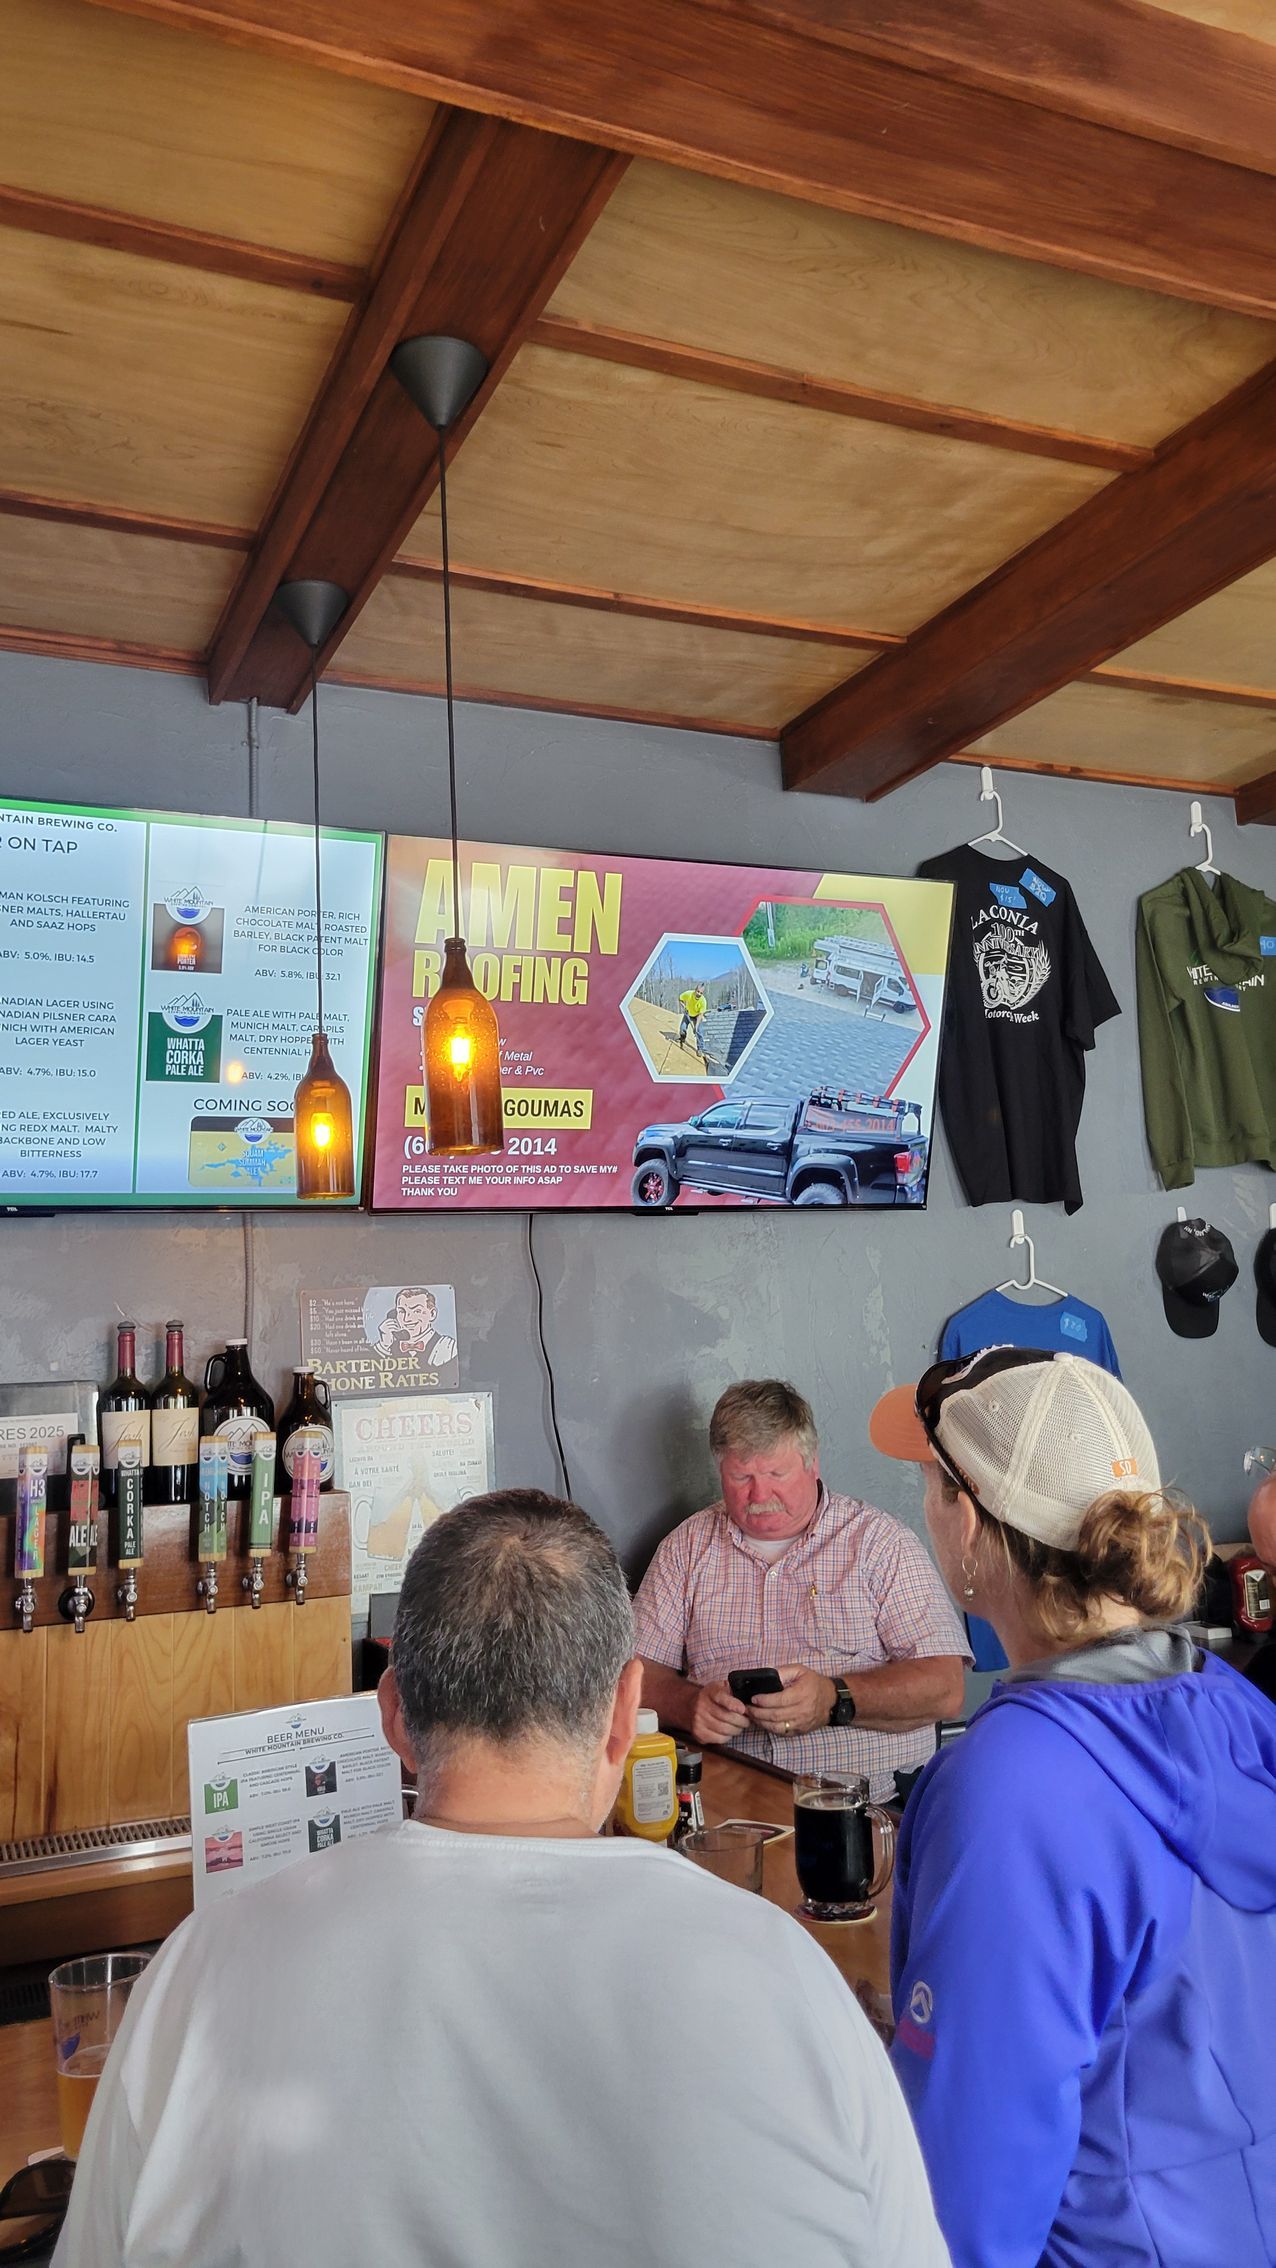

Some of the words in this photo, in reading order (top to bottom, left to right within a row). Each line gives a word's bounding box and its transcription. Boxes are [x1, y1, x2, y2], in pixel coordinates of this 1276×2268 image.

[38, 817, 94, 830] BREWING
[97, 822, 117, 832] CO.
[8, 836, 36, 851] ON
[42, 839, 78, 854] TAP
[26, 893, 69, 904] KOLSCH
[71, 896, 130, 908] FEATURING
[414, 857, 623, 956] AMEN
[27, 906, 63, 917] MALTS,
[66, 909, 126, 921] HALLERTAU
[244, 905, 295, 917] AMERICAN
[297, 909, 337, 920] PORER,
[338, 912, 361, 921] RICH
[970, 904, 1040, 935] LACONIA
[10, 919, 34, 928] AND
[36, 920, 65, 930] SAAZ
[67, 922, 96, 932] HOPS
[236, 917, 294, 929] CHOCOLATE
[324, 923, 368, 934] ROASTED
[274, 932, 304, 942] BLACK
[344, 936, 369, 946] MALT
[258, 944, 278, 953] FOR
[279, 945, 310, 955] BLACK
[54, 953, 74, 962] IBU:
[77, 954, 95, 963] 14.5
[254, 969, 277, 978] ABV:
[411, 948, 589, 1006] ROFING
[0, 996, 43, 1007] NADIAN
[46, 999, 80, 1009] LAGER
[82, 1001, 114, 1010] USING
[160, 1004, 180, 1012] WHITE
[43, 1012, 86, 1022] PILSNER
[88, 1014, 117, 1023] CARA
[226, 1008, 250, 1018] PALE
[252, 1009, 270, 1019] ALE
[272, 1010, 296, 1020] WITH
[1013, 1009, 1040, 1024] Week
[0, 1023, 27, 1032] NICH
[30, 1024, 57, 1034] WITH
[60, 1026, 115, 1036] AMERICAN
[230, 1021, 270, 1031] MUNICH
[15, 1037, 50, 1046] LAGER
[52, 1038, 85, 1047] YEAST
[167, 1037, 205, 1051] WHATTA
[259, 1035, 278, 1043] DRY
[280, 1035, 313, 1044] HOPPE
[166, 1049, 204, 1065] CORKA
[243, 1046, 303, 1056] CENTENNIAL
[504, 1049, 533, 1062] Metal
[55, 1069, 76, 1077] IBU:
[78, 1069, 96, 1077] 15.0
[165, 1064, 187, 1076] PALE
[187, 1065, 204, 1076] ALE
[242, 1072, 263, 1080] ABV:
[515, 1066, 523, 1076] &
[525, 1065, 545, 1077] Pvc
[193, 1098, 262, 1112] COMING
[503, 1097, 585, 1118] GOUMAS
[43, 1112, 110, 1121] EXCLUSIVELY
[19, 1124, 48, 1132] REDX
[85, 1125, 119, 1134] MALTY
[57, 1137, 80, 1146] AND
[82, 1137, 106, 1146] LOW
[507, 1136, 558, 1156] 2014
[20, 1149, 82, 1158] BITTERNESS
[1, 1170, 26, 1178] ABV:
[59, 1170, 79, 1178] IBU:
[80, 1170, 98, 1179] 17.7
[402, 1163, 442, 1174] PLEASE
[442, 1164, 470, 1174] TAKE
[470, 1164, 504, 1174] PHOTO
[505, 1164, 519, 1174] OF
[520, 1164, 543, 1174] THIS
[543, 1164, 558, 1174] AD
[558, 1165, 573, 1174] TO
[573, 1165, 598, 1174] SAVE
[599, 1164, 618, 1175] MY#
[402, 1175, 442, 1185] PLEASE
[442, 1175, 468, 1185] TEXT
[468, 1175, 482, 1185] ME
[485, 1175, 512, 1186] YOUR
[513, 1175, 536, 1186] INFO
[536, 1175, 563, 1186] ASAP
[401, 1186, 435, 1196] THANK
[436, 1186, 458, 1197] YOU
[307, 1357, 422, 1374] BARTENDER
[379, 1372, 440, 1389] RATES
[30, 1425, 65, 1439] 2025
[355, 1411, 473, 1441] CHEERS
[29, 1478, 46, 1498] H3
[258, 1472, 271, 1525] IPA
[126, 1478, 134, 1539] CORKA
[68, 1525, 87, 1547] ALE
[267, 1733, 293, 1744] BEER
[295, 1726, 325, 1739] MENU
[245, 1746, 266, 1755] WHITE
[267, 1739, 301, 1751] MOUNTAIN
[302, 1735, 333, 1747] BREWING
[213, 1792, 229, 1809] IPA
